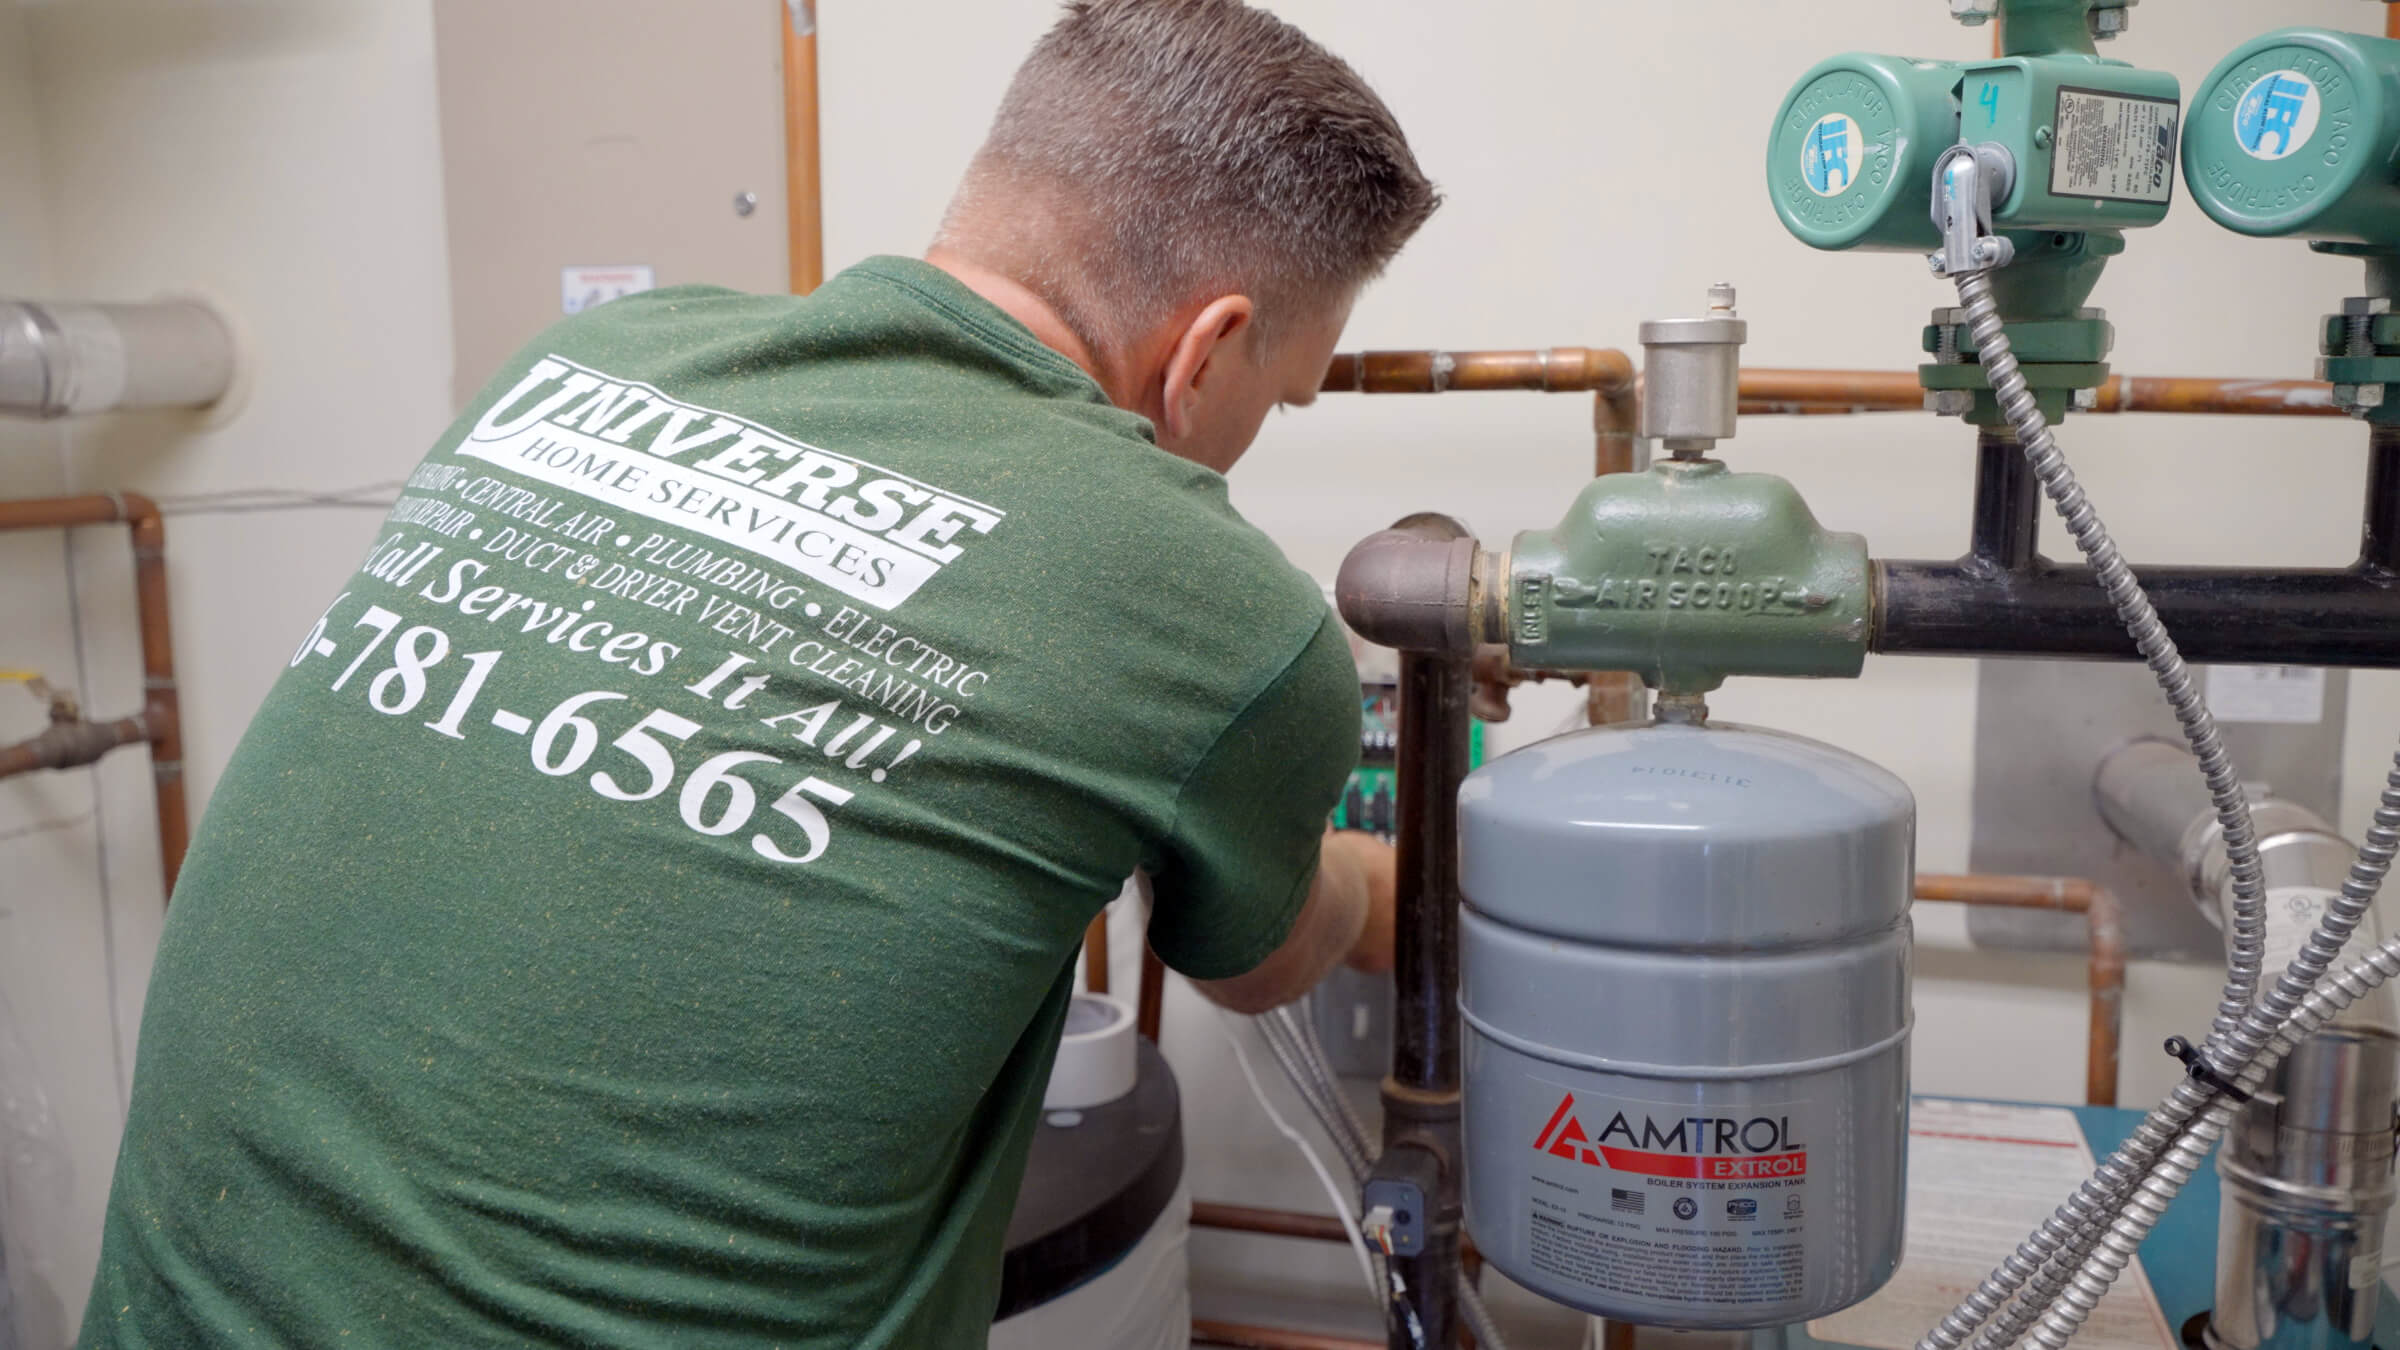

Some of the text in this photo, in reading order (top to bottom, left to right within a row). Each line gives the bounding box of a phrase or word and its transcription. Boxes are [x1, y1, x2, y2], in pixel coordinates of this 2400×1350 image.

[1978, 81, 1999, 128] 4
[470, 357, 1002, 564] UNIVERSE
[520, 437, 896, 589] HOME SERVICES
[460, 476, 565, 528] CENTRAL
[552, 510, 616, 546] AIR
[628, 532, 804, 610] PLUMBING
[821, 606, 989, 697] ELECTRIC
[1648, 547, 1738, 576] TACO
[408, 497, 475, 538] REPAIR
[482, 526, 576, 573] DUCT
[565, 553, 600, 580] &
[589, 563, 699, 615] DRYER
[697, 595, 794, 654] VENT
[789, 640, 961, 736] CLEANING
[1521, 578, 1543, 645] INLET
[362, 532, 922, 784] Call Services It All!
[1598, 1111, 1803, 1153] AMTROL
[1647, 1178, 1805, 1190] BOILER SYSTEM EXPANSION TANK
[1714, 1157, 1803, 1177] EXTROL
